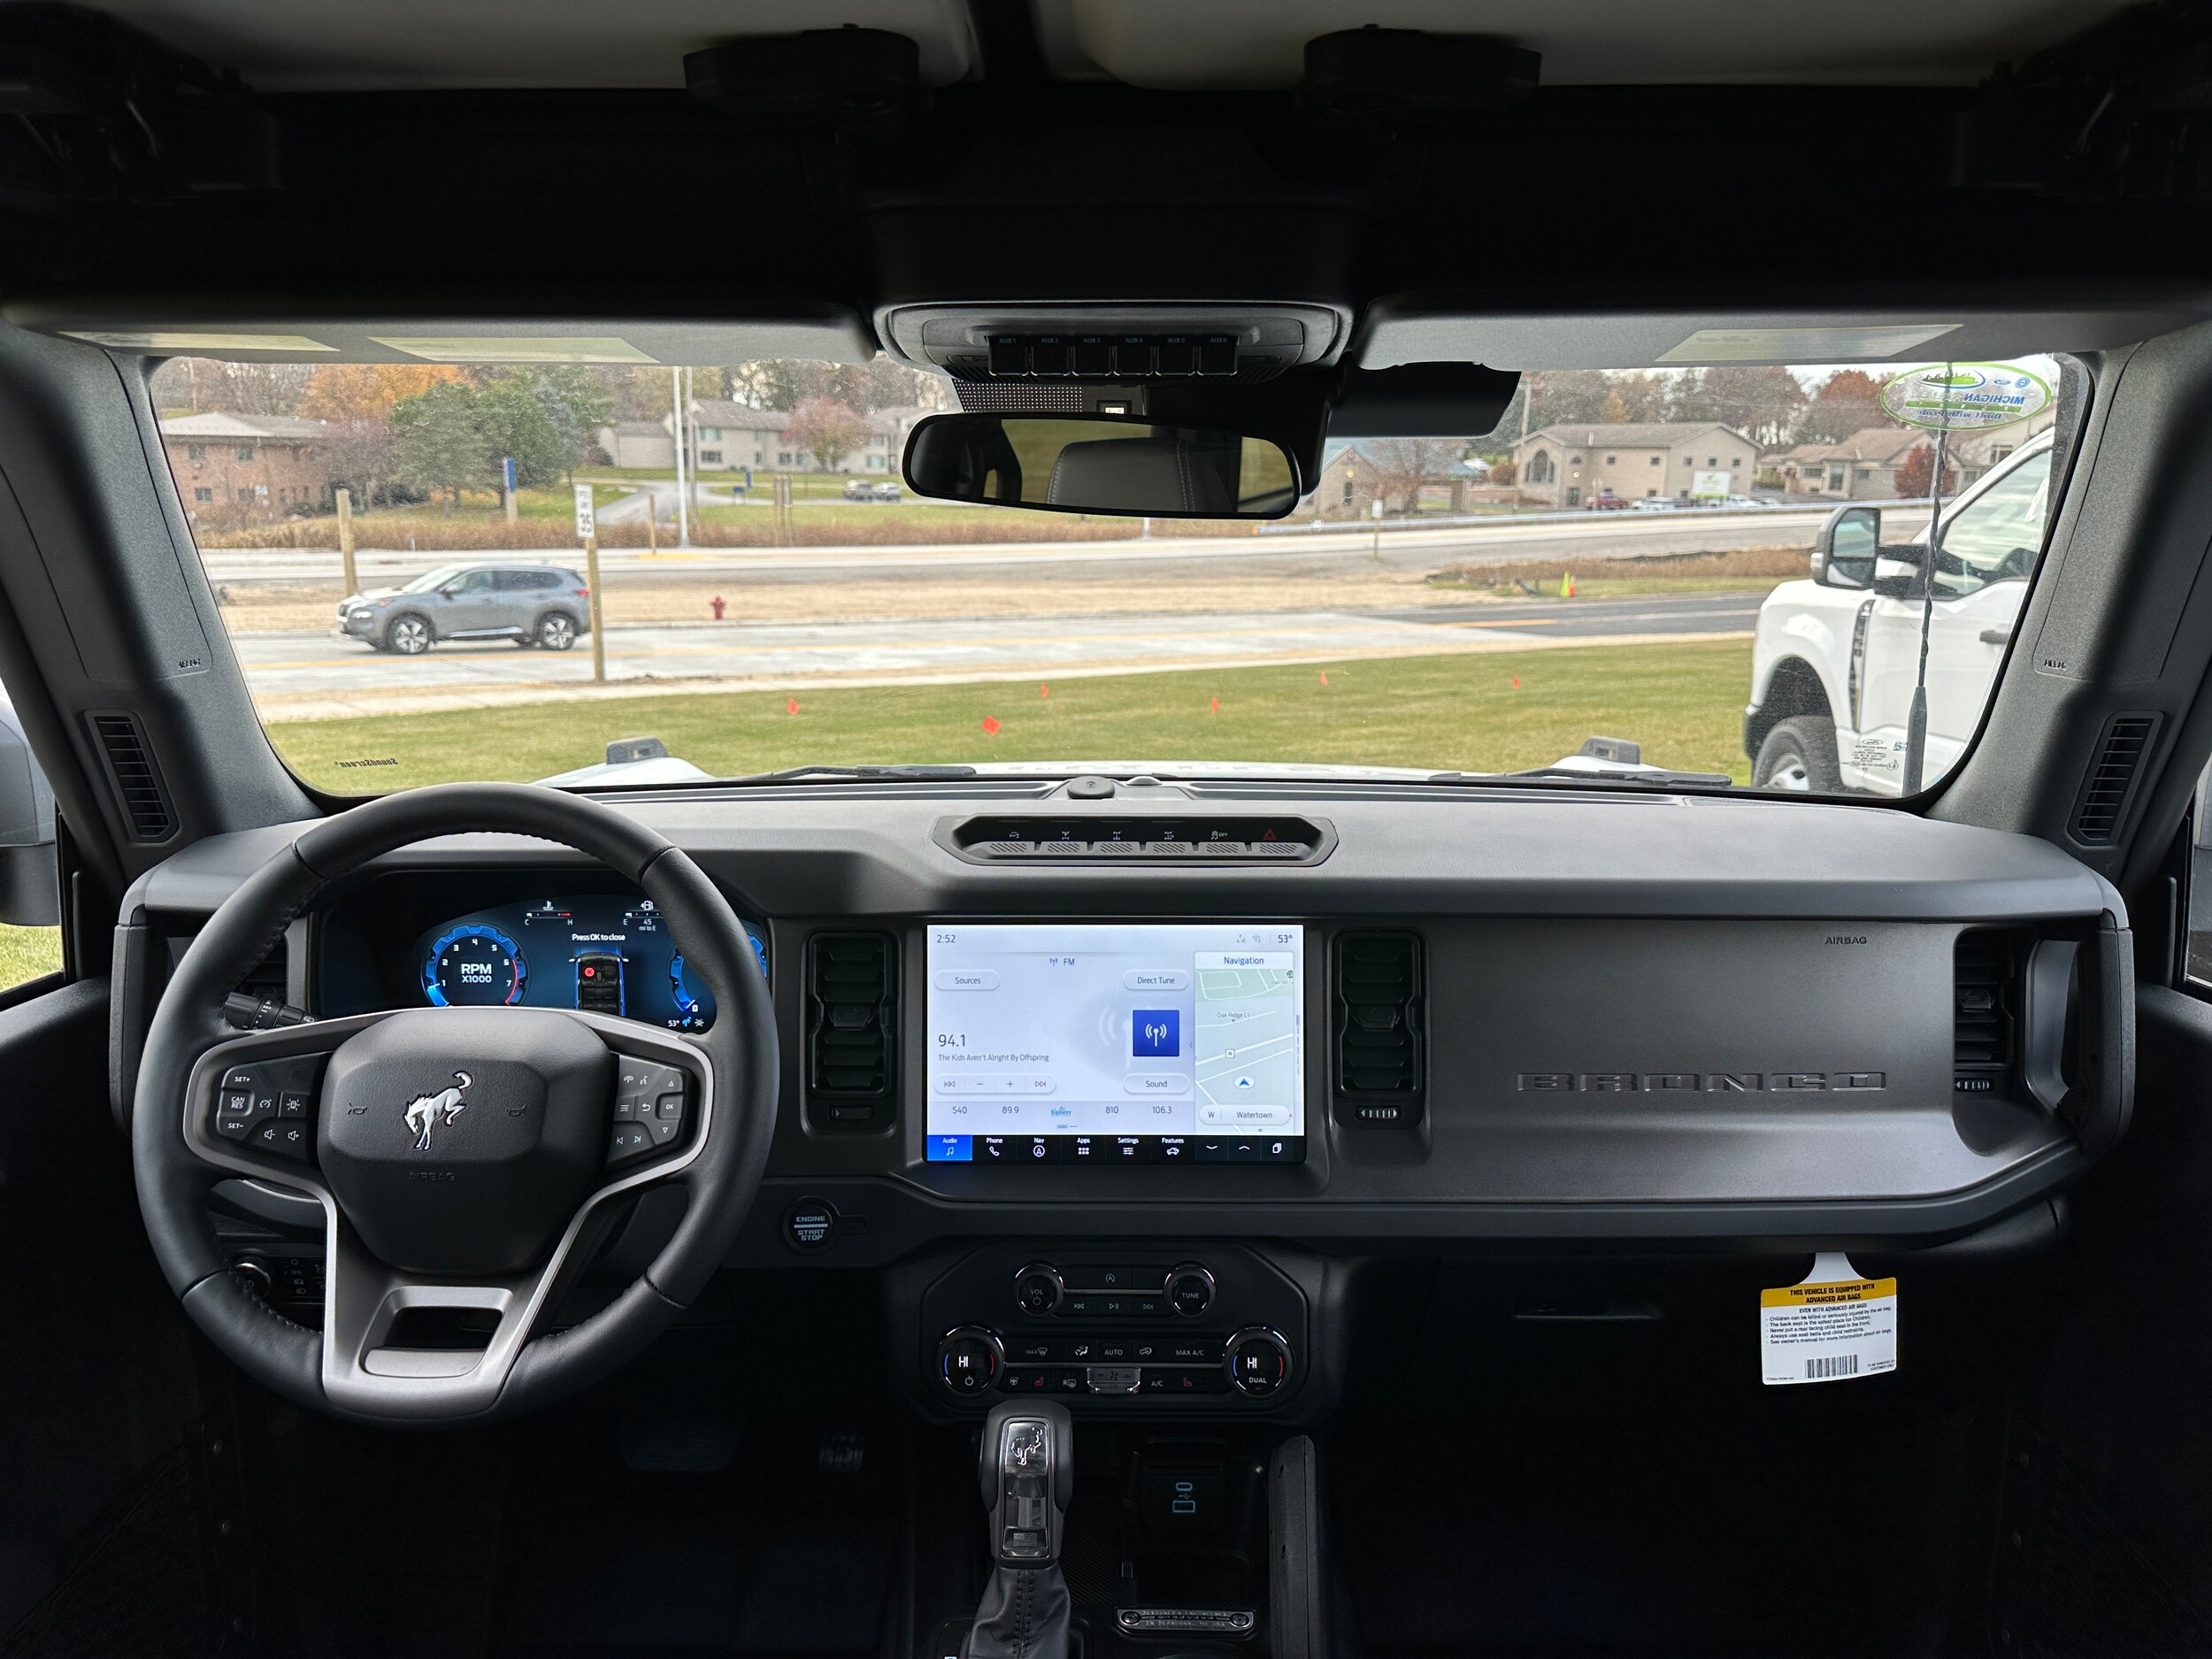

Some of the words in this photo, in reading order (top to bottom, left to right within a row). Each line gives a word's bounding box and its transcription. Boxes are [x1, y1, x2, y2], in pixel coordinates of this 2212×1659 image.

[580, 513, 592, 533] 35
[936, 934, 956, 943] 2:52
[1278, 934, 1293, 943] 53°
[1224, 956, 1263, 965] Navigation
[461, 964, 492, 974] RPM
[938, 1034, 965, 1047] 94.1
[1517, 1072, 1886, 1092] BRONCO
[408, 1172, 455, 1181] AIRBAG
[958, 1356, 968, 1367] HI
[1247, 1357, 1257, 1369] HI
